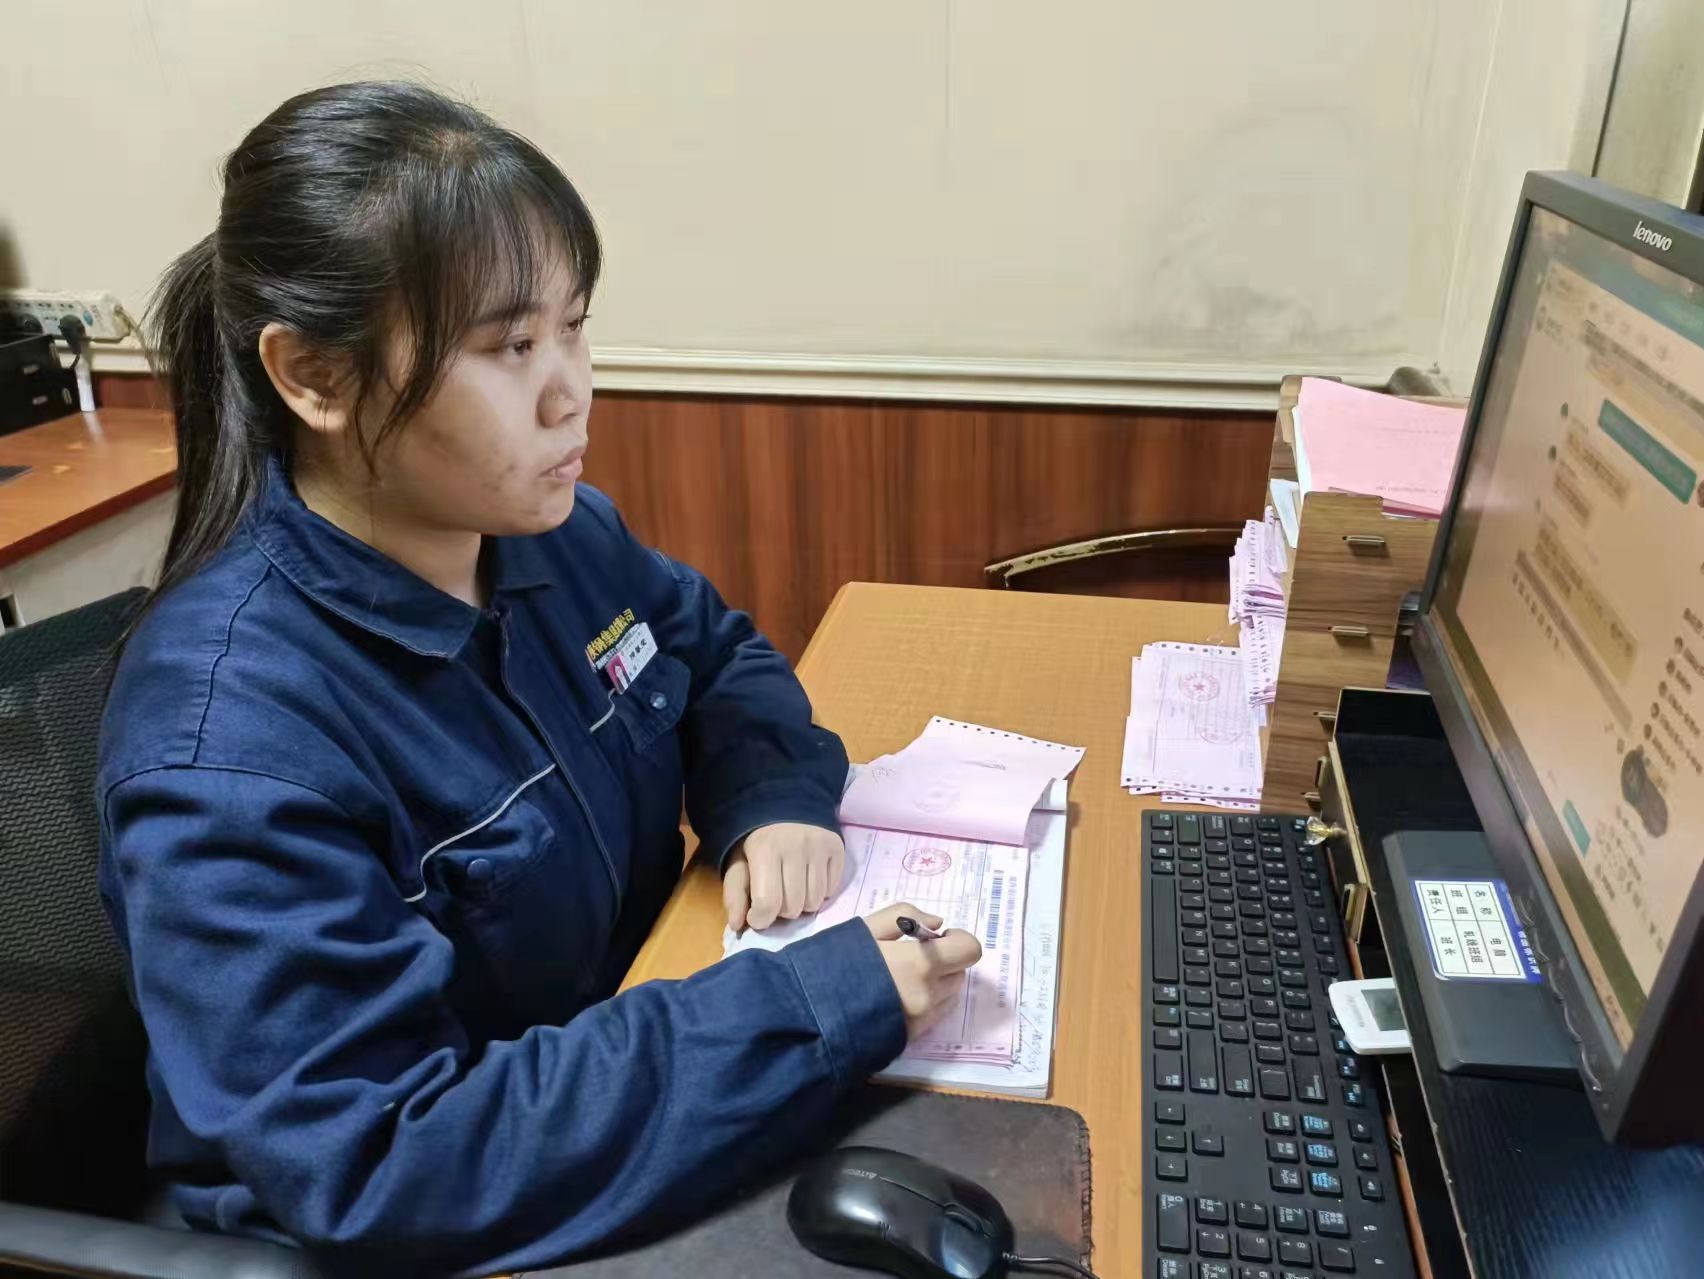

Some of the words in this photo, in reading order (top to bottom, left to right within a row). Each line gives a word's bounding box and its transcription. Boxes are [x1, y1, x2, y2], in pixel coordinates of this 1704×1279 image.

[1632, 220, 1672, 251] lenovo
[1426, 889, 1445, 914] 责任人
[1474, 889, 1492, 915] 名称
